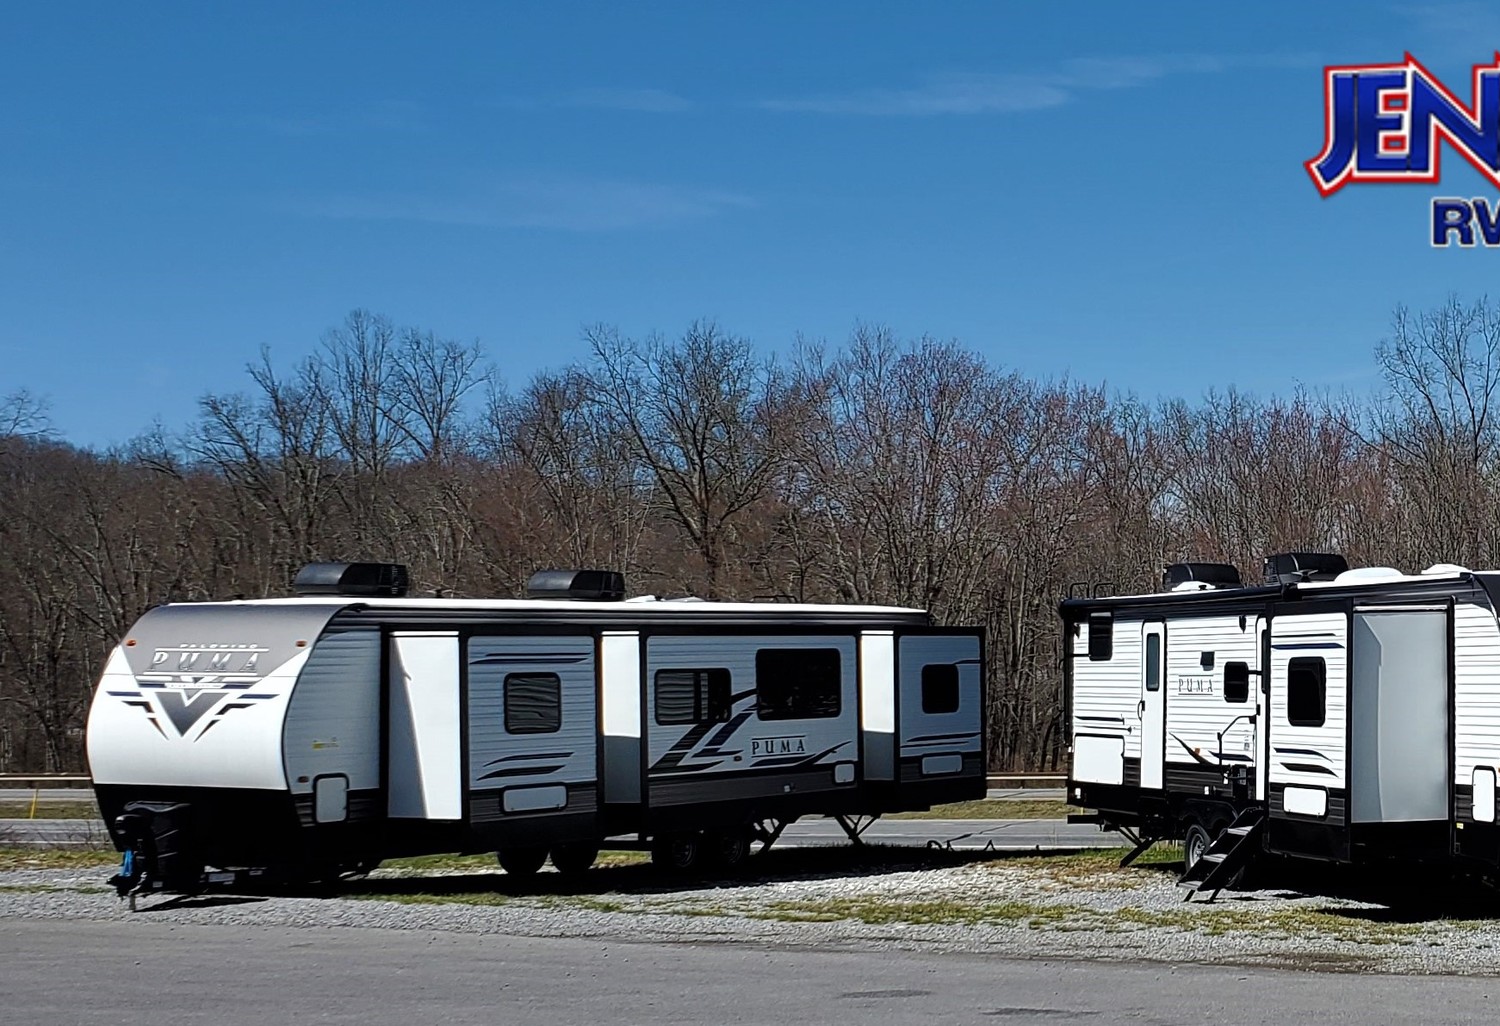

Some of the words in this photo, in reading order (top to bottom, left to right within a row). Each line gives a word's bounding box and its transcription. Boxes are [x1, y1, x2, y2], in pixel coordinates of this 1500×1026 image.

[146, 652, 260, 671] PUMA
[1178, 678, 1213, 692] PUMA
[751, 739, 805, 755] PUMA
